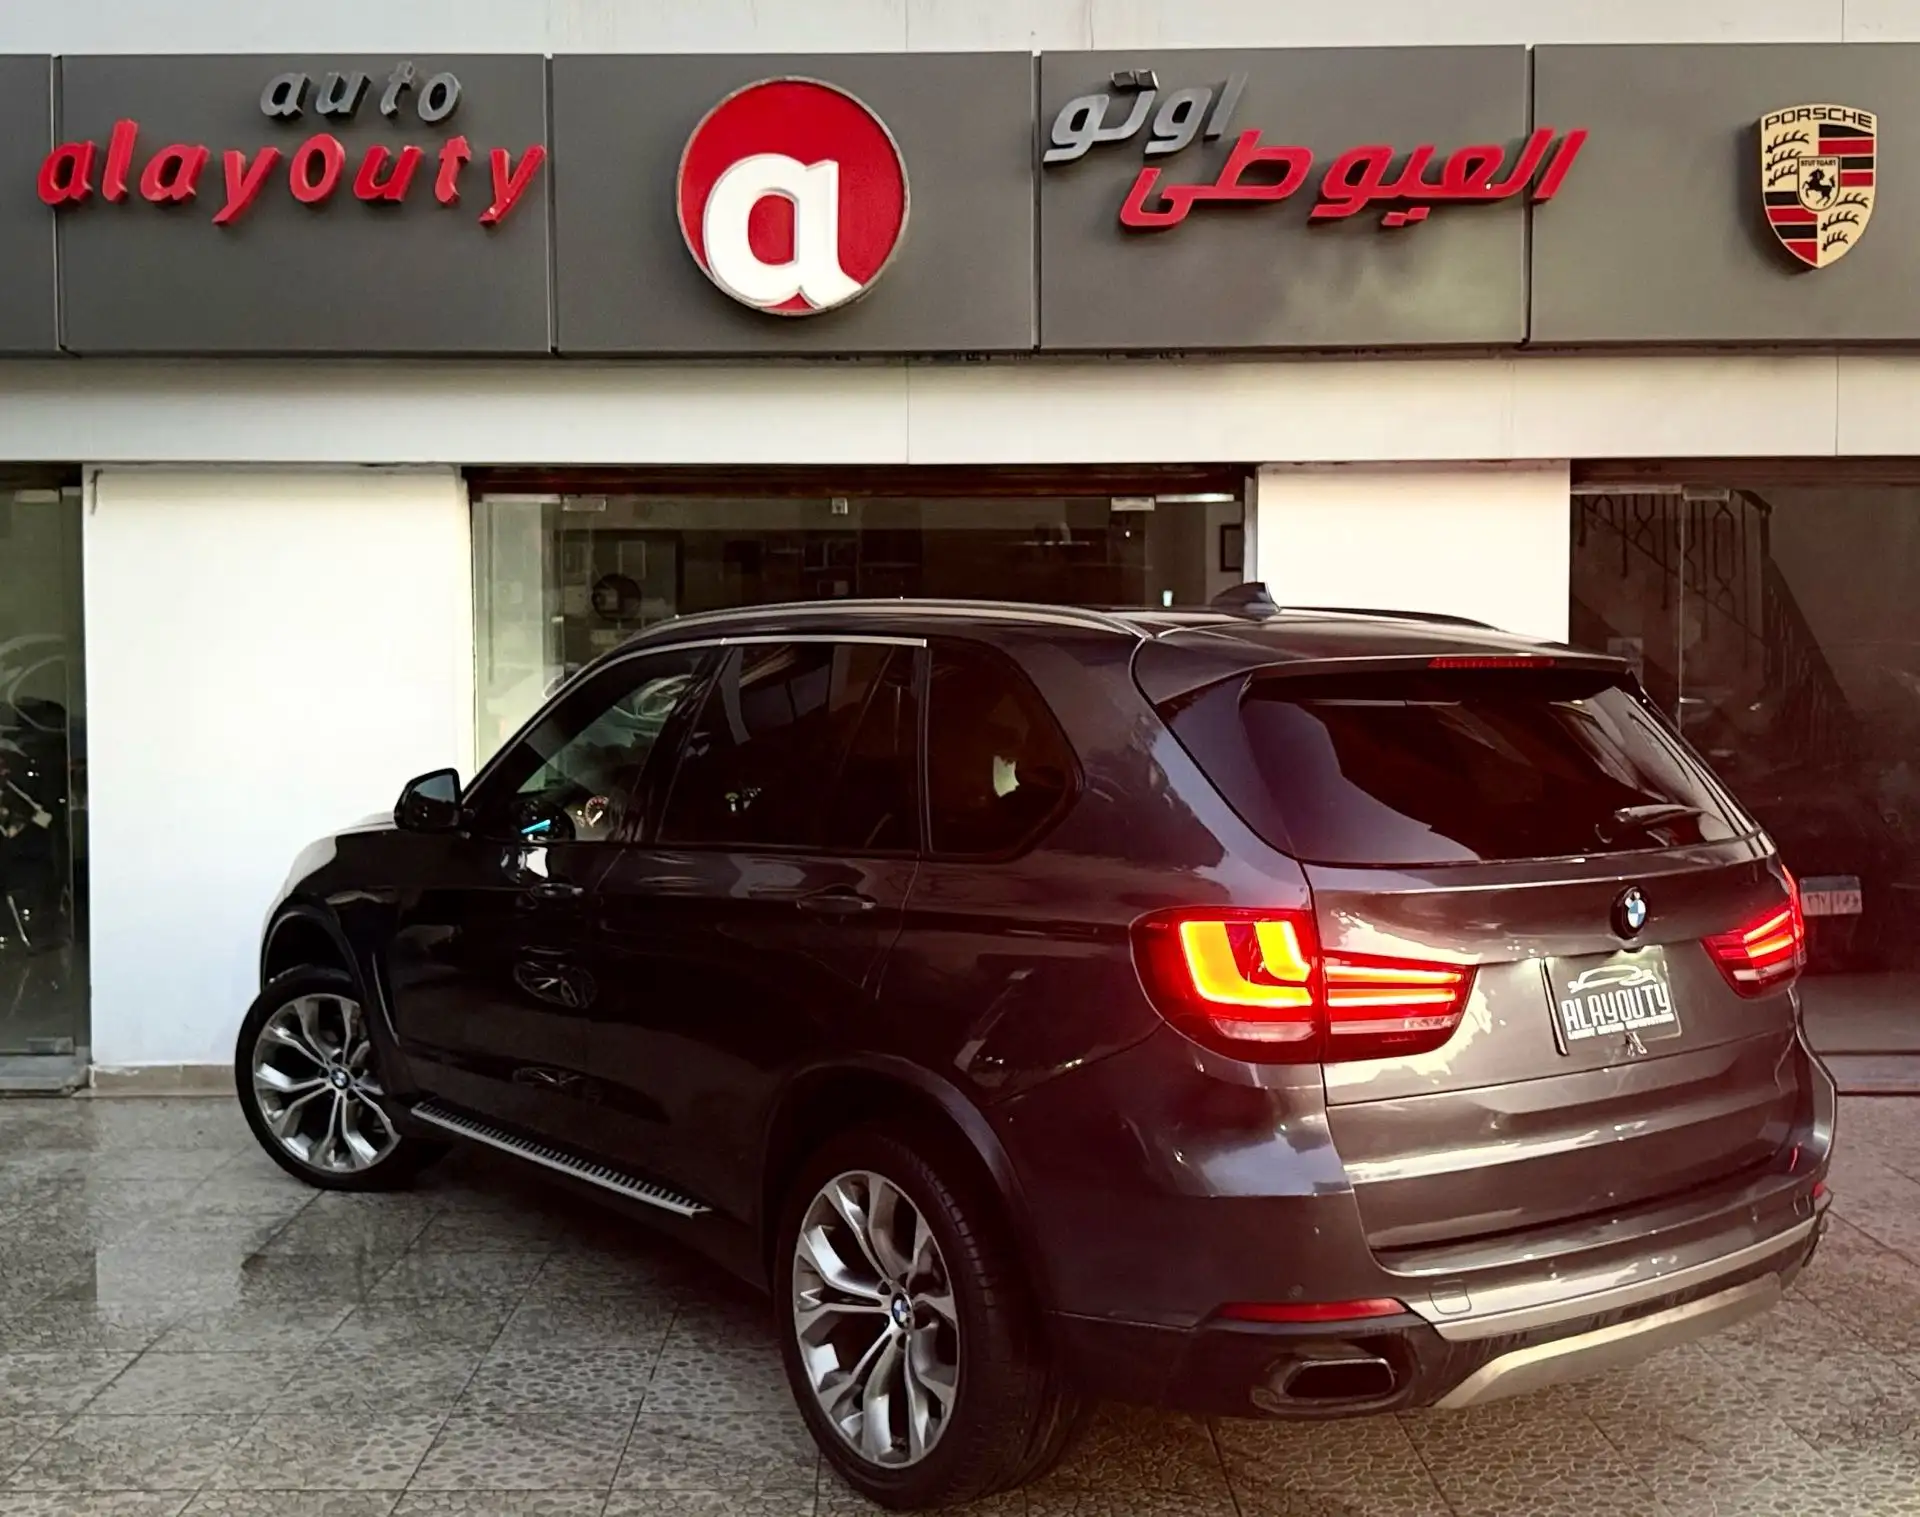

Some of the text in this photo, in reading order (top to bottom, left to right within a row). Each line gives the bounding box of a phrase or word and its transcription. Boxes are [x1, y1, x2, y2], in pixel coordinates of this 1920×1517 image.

[260, 61, 462, 122] auto
[1043, 68, 1248, 163] اوتو
[1764, 107, 1872, 130] PORSCHE
[702, 152, 864, 310] a
[1560, 982, 1672, 1032] ALAYOUTY
